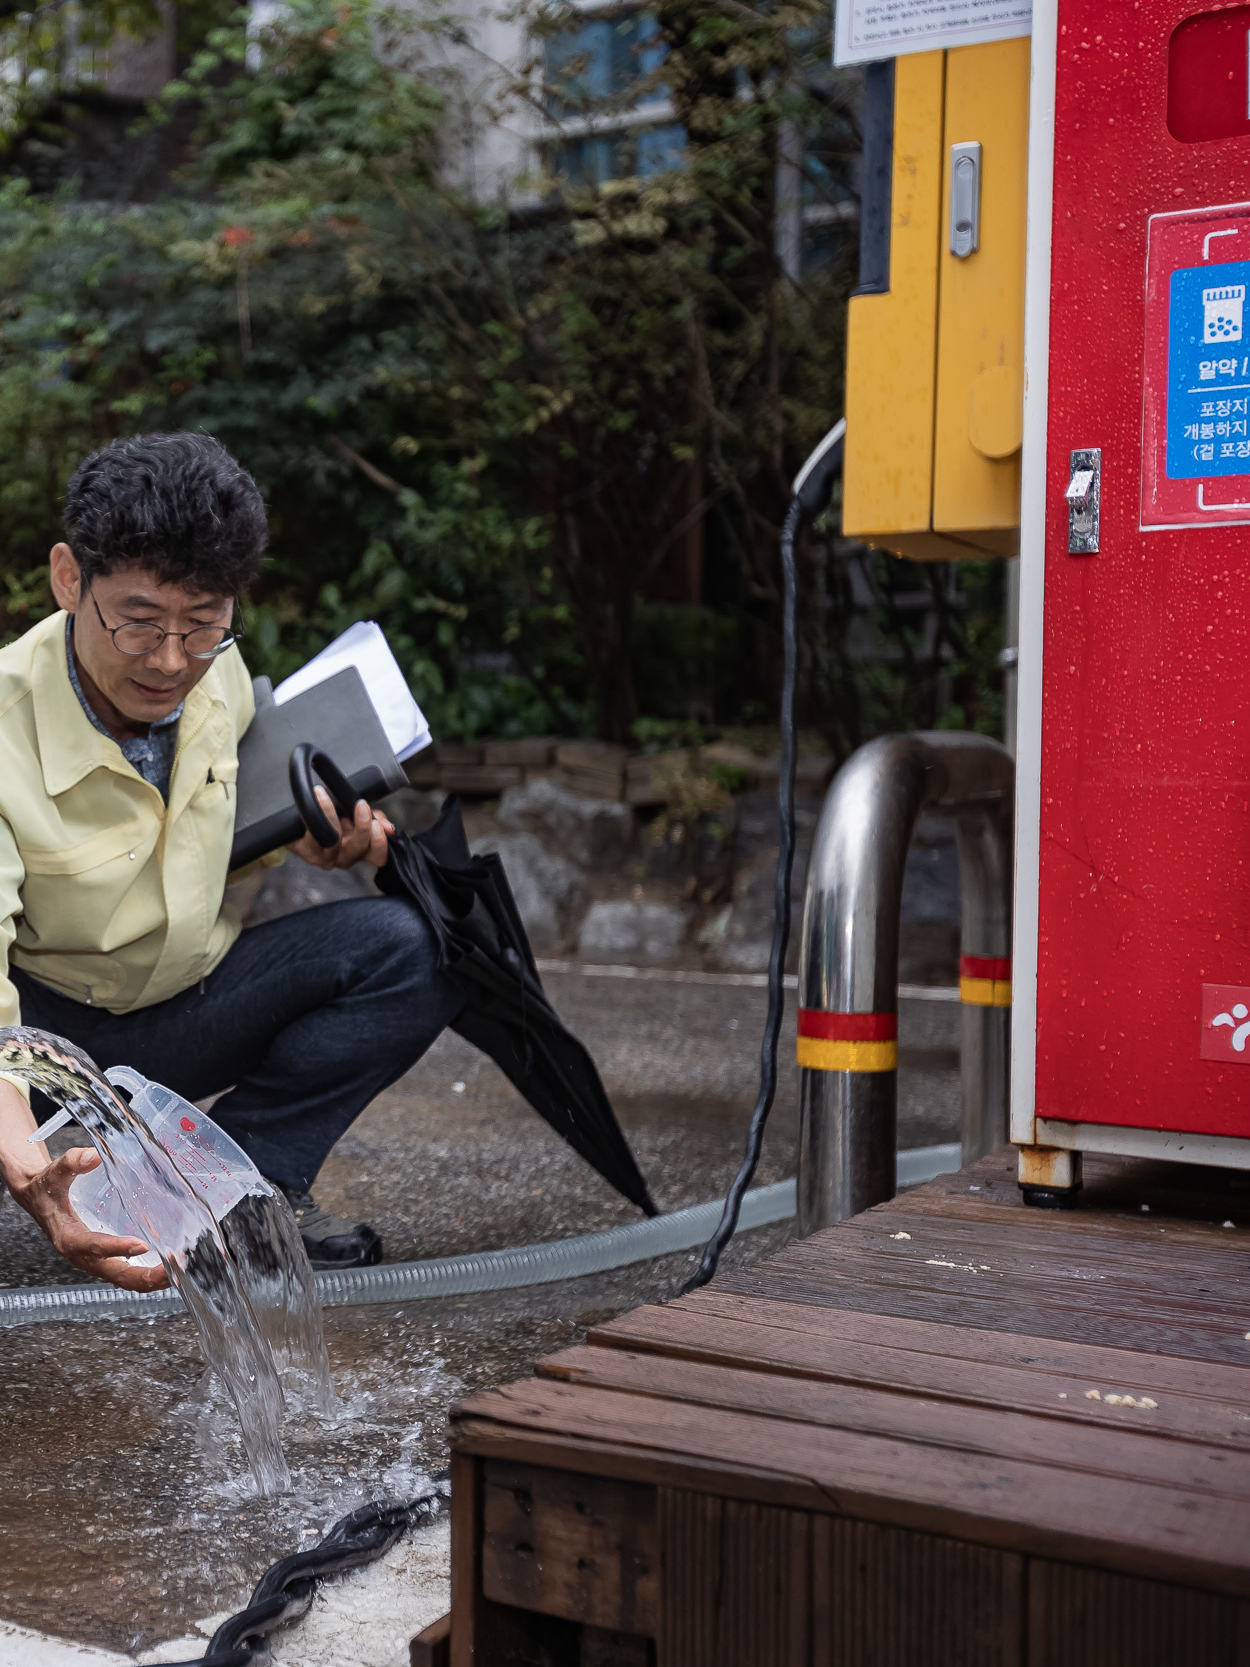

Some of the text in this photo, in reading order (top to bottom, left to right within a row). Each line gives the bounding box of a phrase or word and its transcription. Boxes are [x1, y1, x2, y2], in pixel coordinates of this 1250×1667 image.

[1199, 358, 1238, 380] 알약
[1200, 398, 1248, 417] 포장지
[1183, 419, 1247, 440] 개봉하지
